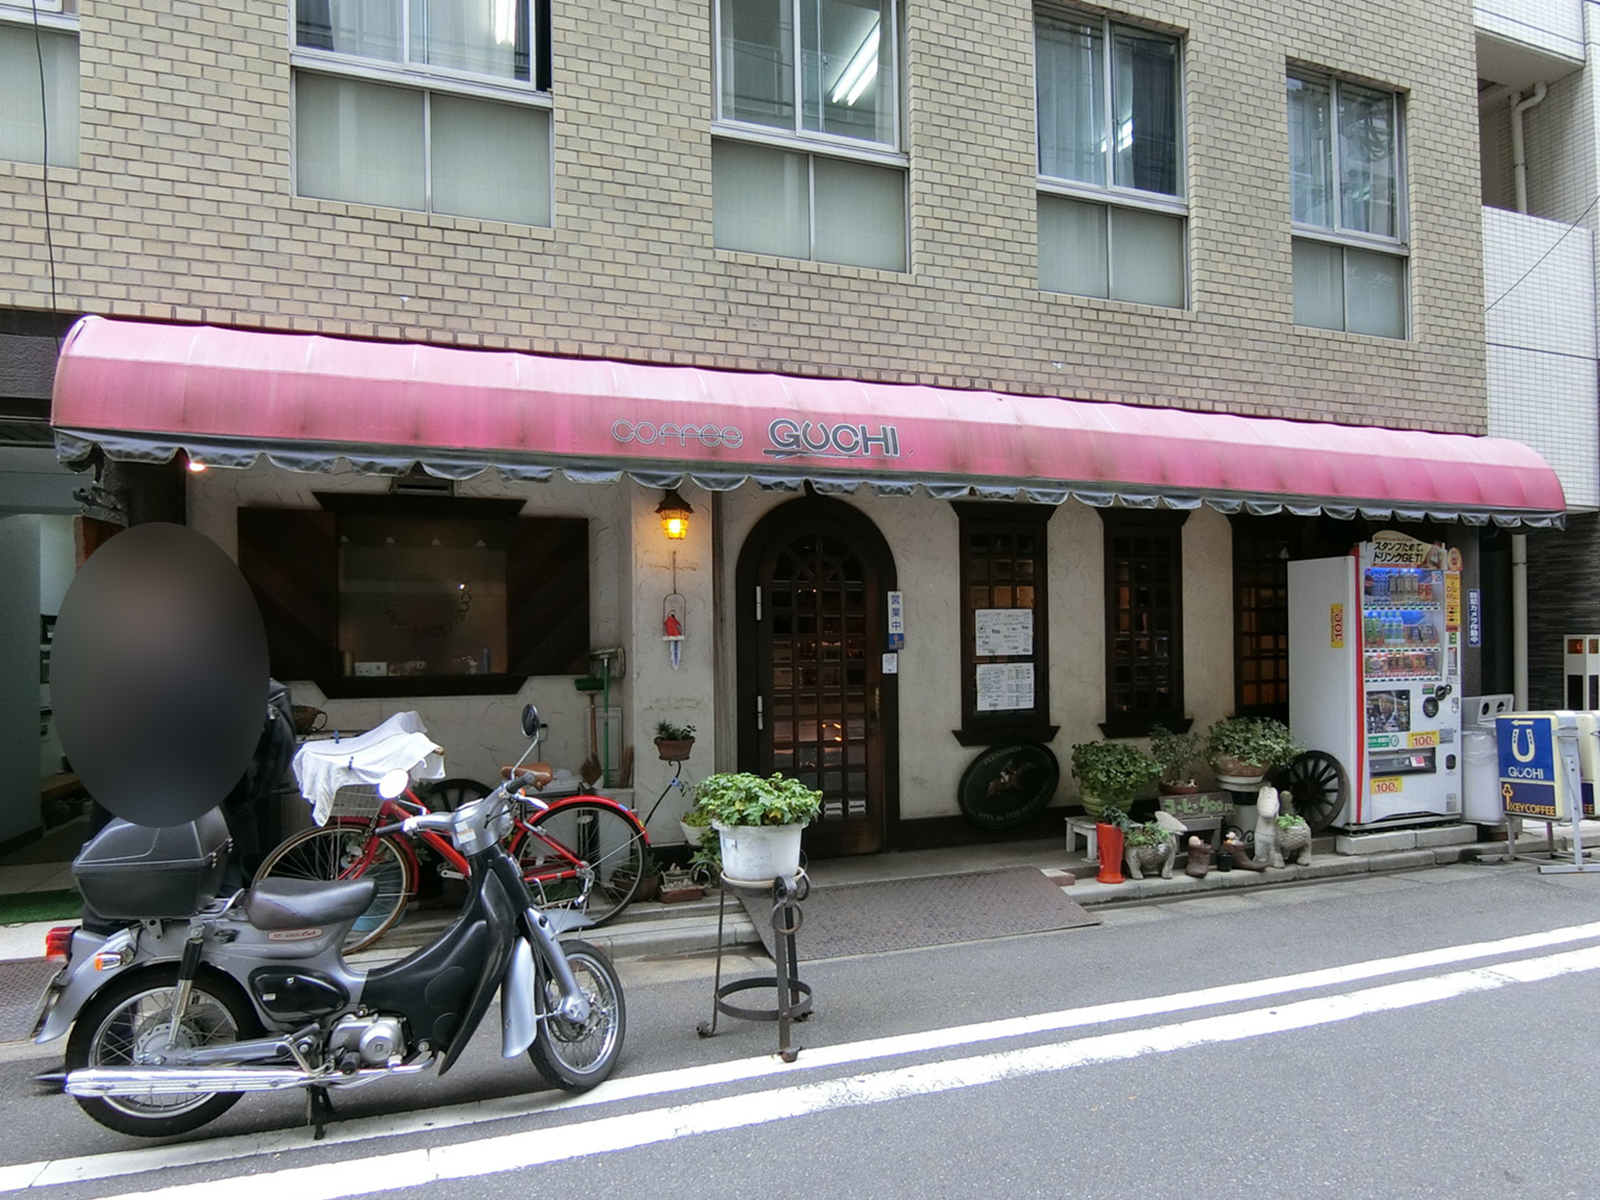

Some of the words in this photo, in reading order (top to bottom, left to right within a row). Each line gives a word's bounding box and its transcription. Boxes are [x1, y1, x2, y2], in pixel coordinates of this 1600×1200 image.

[768, 418, 900, 457] GUCHI
[891, 594, 901, 631] 営業中
[1508, 766, 1544, 779] GUCHI
[1525, 803, 1555, 815] COFFEE
